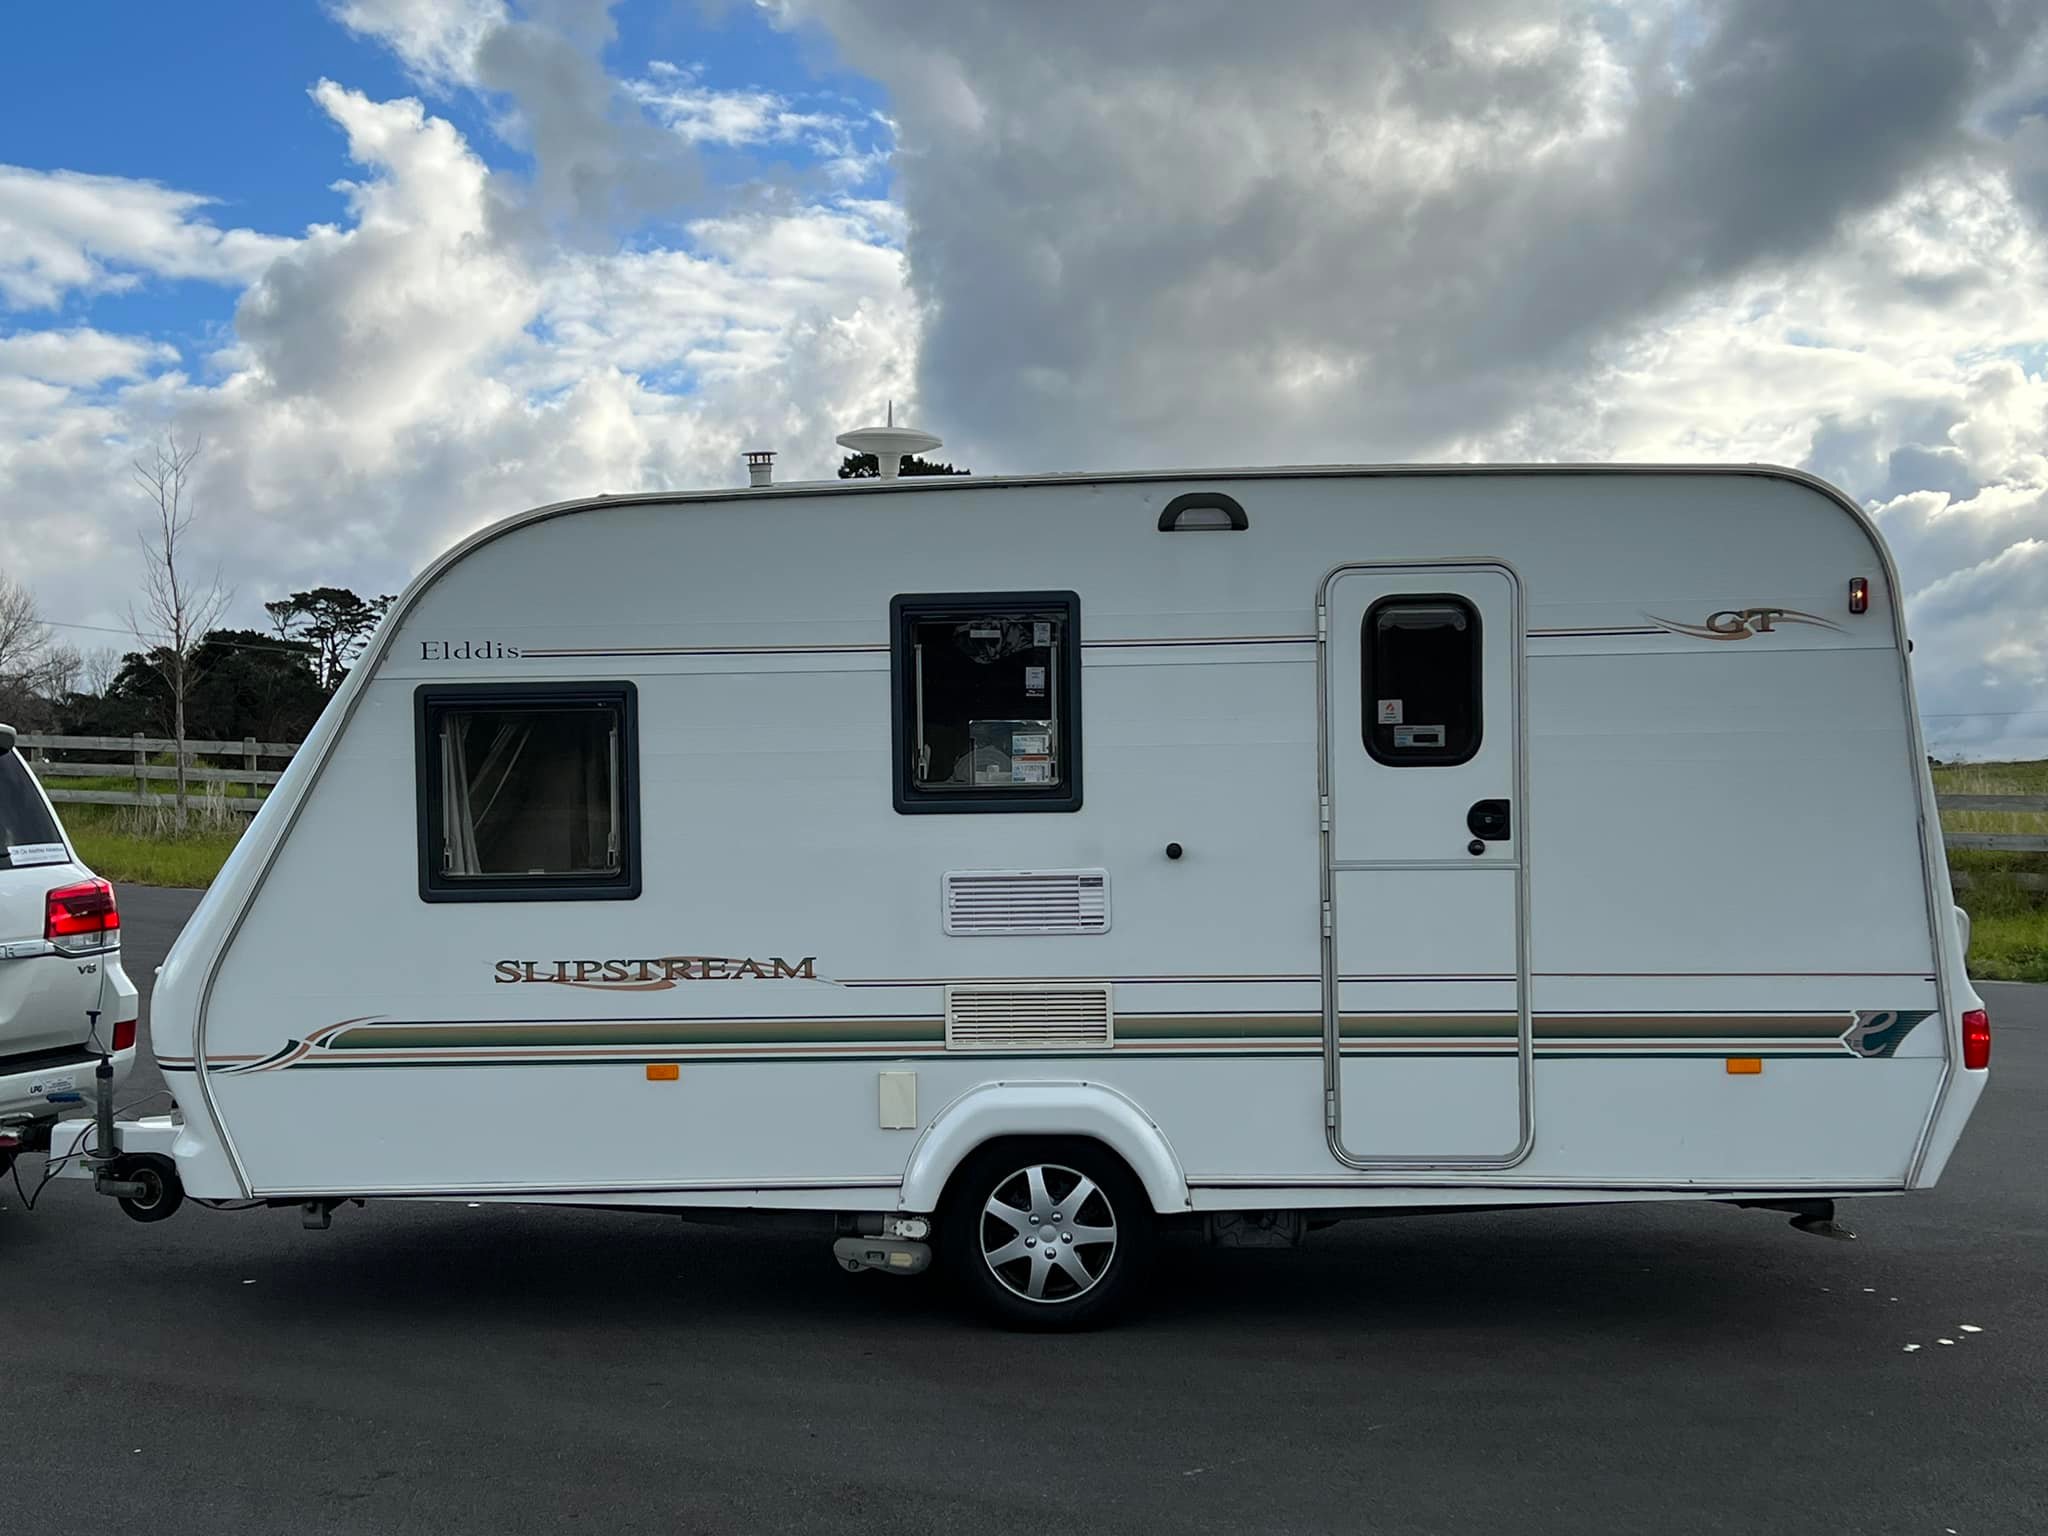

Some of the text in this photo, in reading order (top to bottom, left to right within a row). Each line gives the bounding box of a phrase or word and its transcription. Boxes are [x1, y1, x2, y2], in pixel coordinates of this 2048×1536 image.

[1706, 608, 1782, 633] GT
[421, 640, 520, 660] Elddis
[494, 956, 816, 984] SLIPSTREAM
